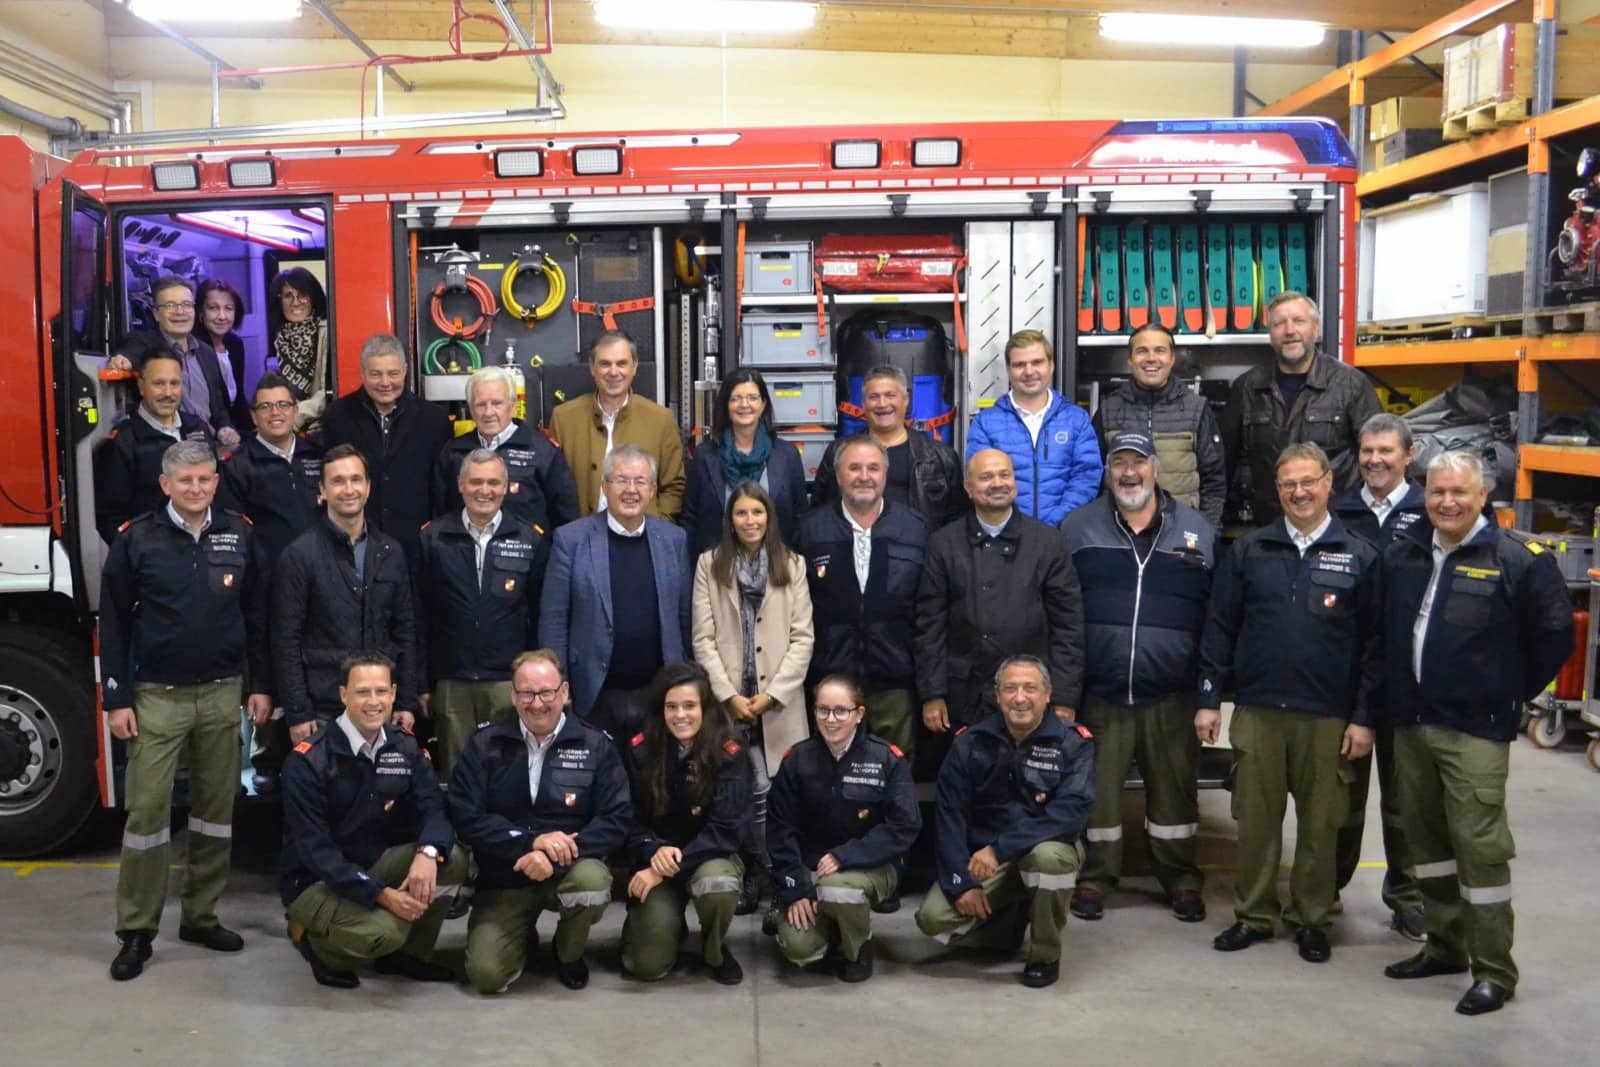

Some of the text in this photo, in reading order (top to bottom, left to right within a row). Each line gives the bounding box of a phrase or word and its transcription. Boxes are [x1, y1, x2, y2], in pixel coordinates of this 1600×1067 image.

[1106, 290, 1114, 302] C
[1132, 289, 1140, 301] C
[1160, 288, 1168, 300] C
[1187, 290, 1195, 302] C
[1214, 289, 1221, 301] C
[1239, 287, 1247, 300] C
